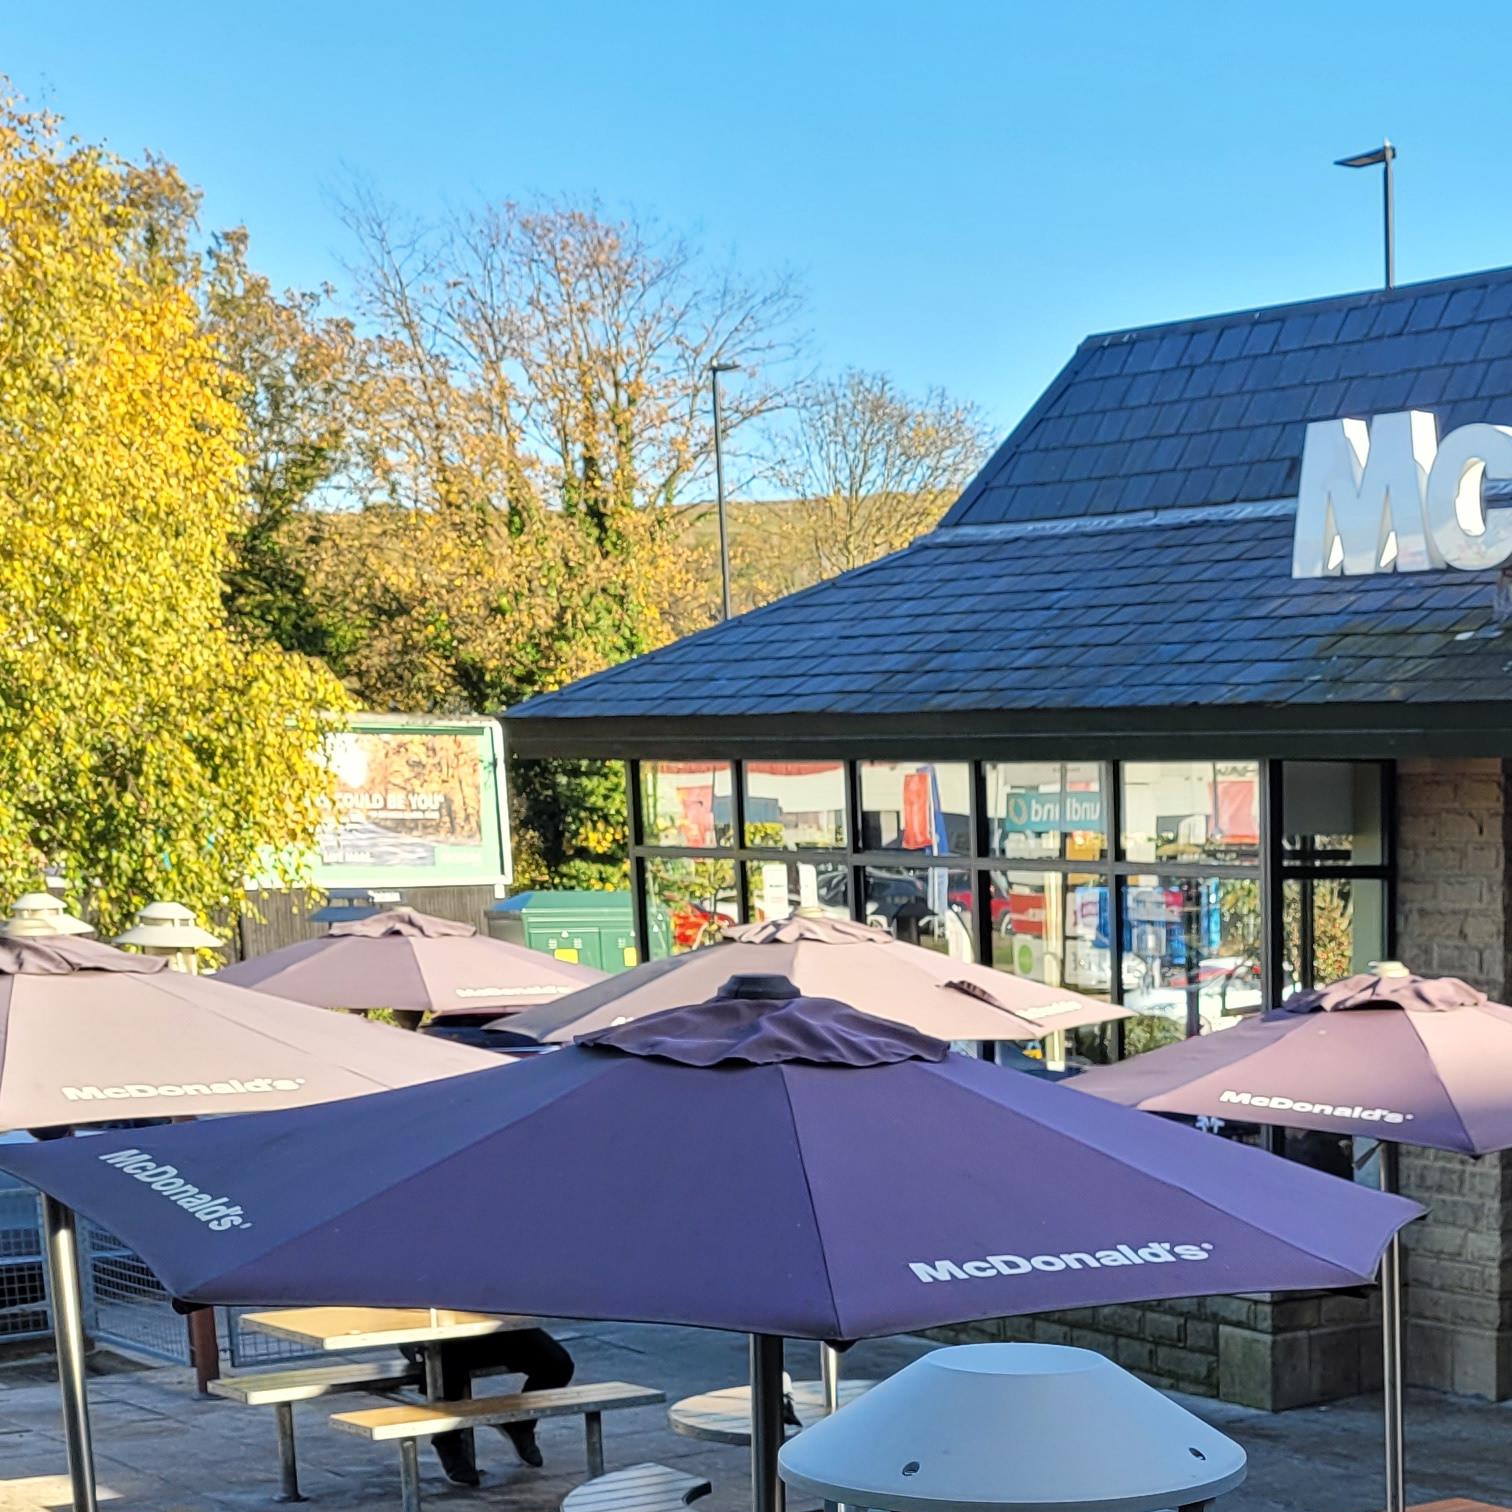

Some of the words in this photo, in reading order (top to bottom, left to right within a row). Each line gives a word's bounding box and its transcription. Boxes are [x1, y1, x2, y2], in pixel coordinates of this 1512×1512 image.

[61, 1078, 304, 1101] McDonald's
[1219, 1091, 1410, 1124] McDonald's
[98, 1148, 250, 1231] McDonald's
[908, 1242, 1213, 1283] McDonald's
